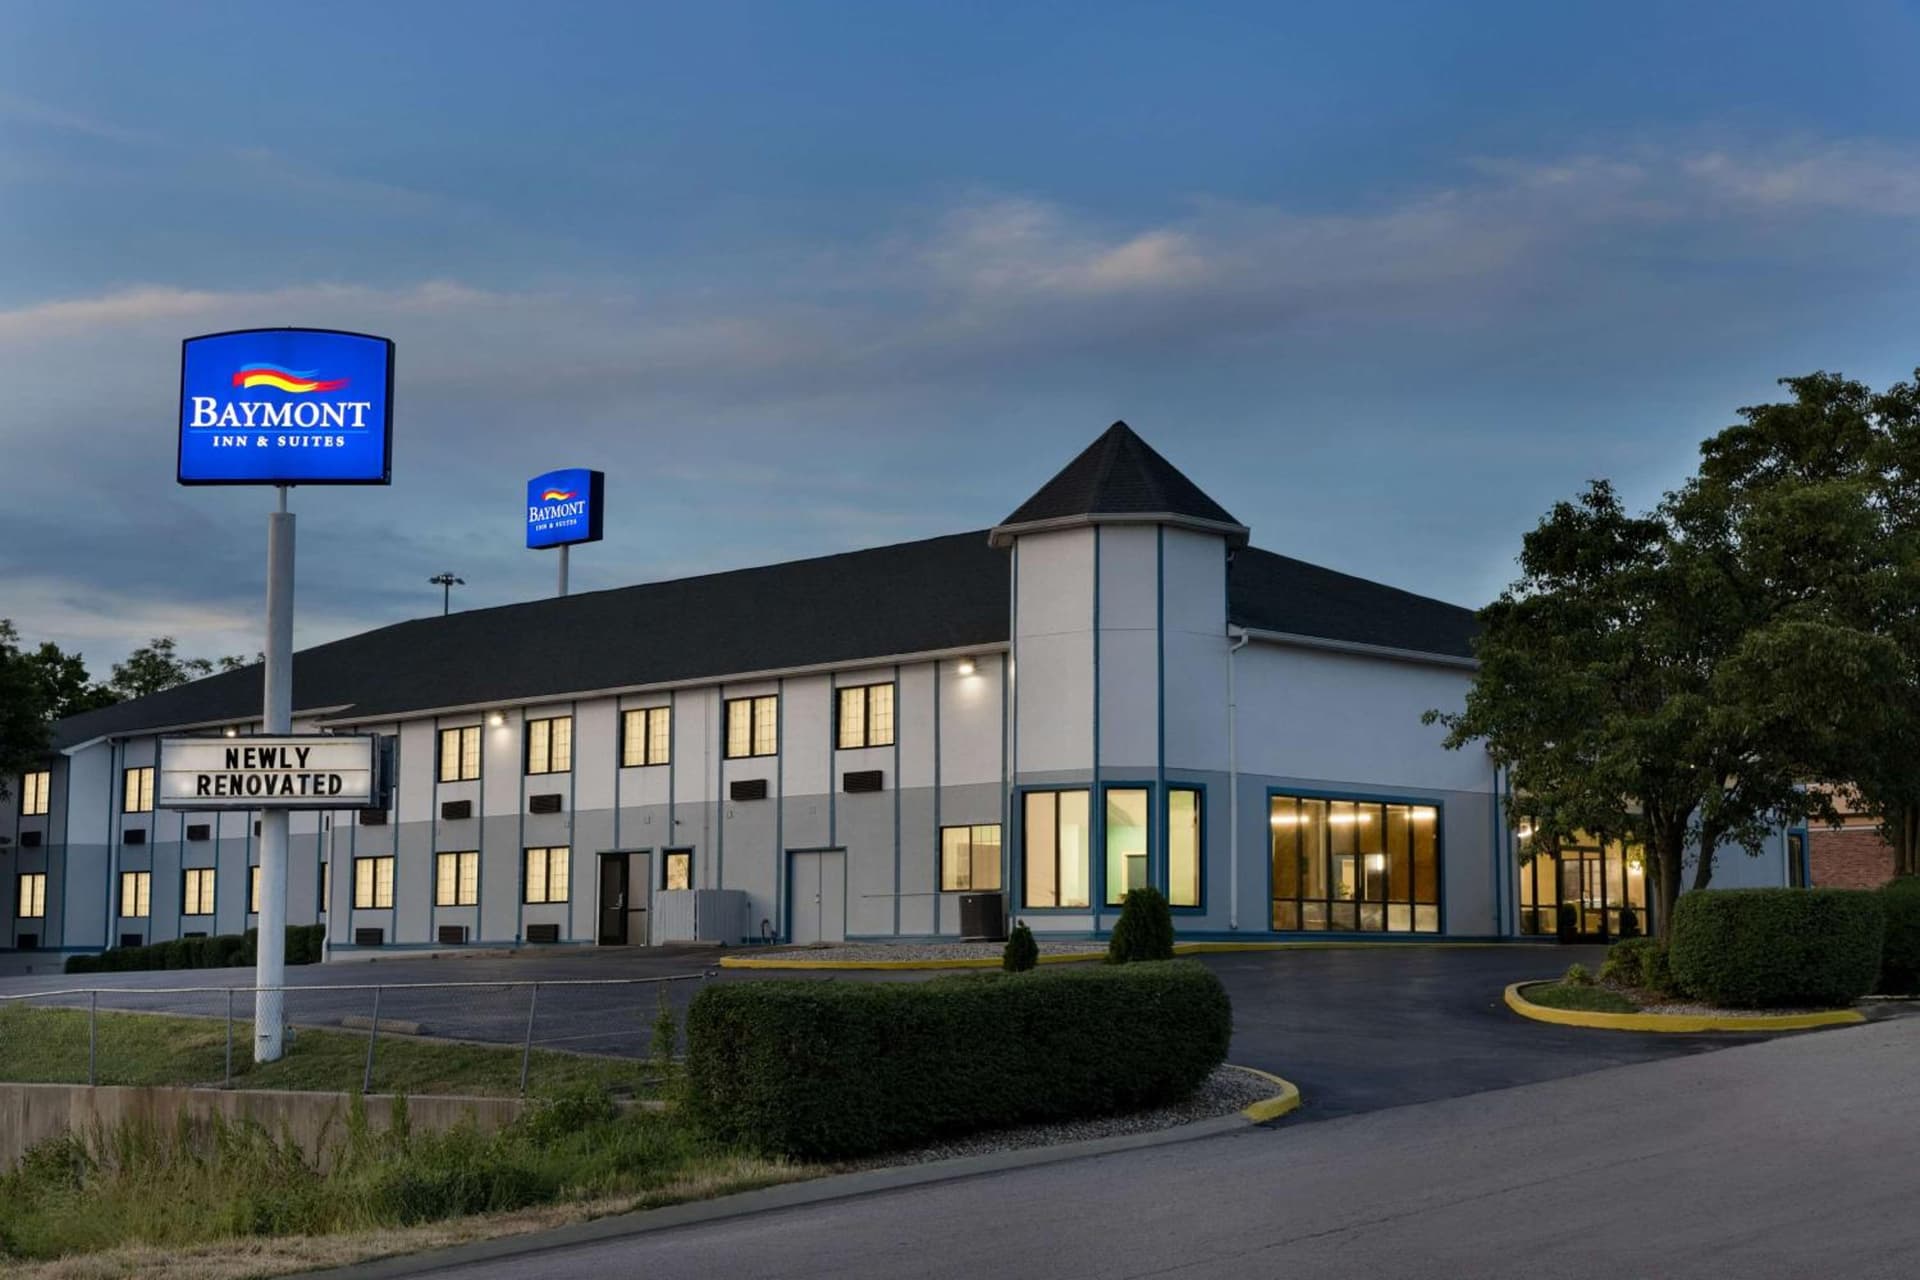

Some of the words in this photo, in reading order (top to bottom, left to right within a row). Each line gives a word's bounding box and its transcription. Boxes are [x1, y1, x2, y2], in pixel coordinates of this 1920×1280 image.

[190, 396, 371, 428] BAYMONT
[213, 436, 248, 447] INN
[256, 436, 269, 447] &
[277, 436, 345, 447] SUITES
[529, 500, 585, 522] BAYMONT
[225, 747, 311, 769] NEWLY
[196, 773, 343, 796] RENOVATED
